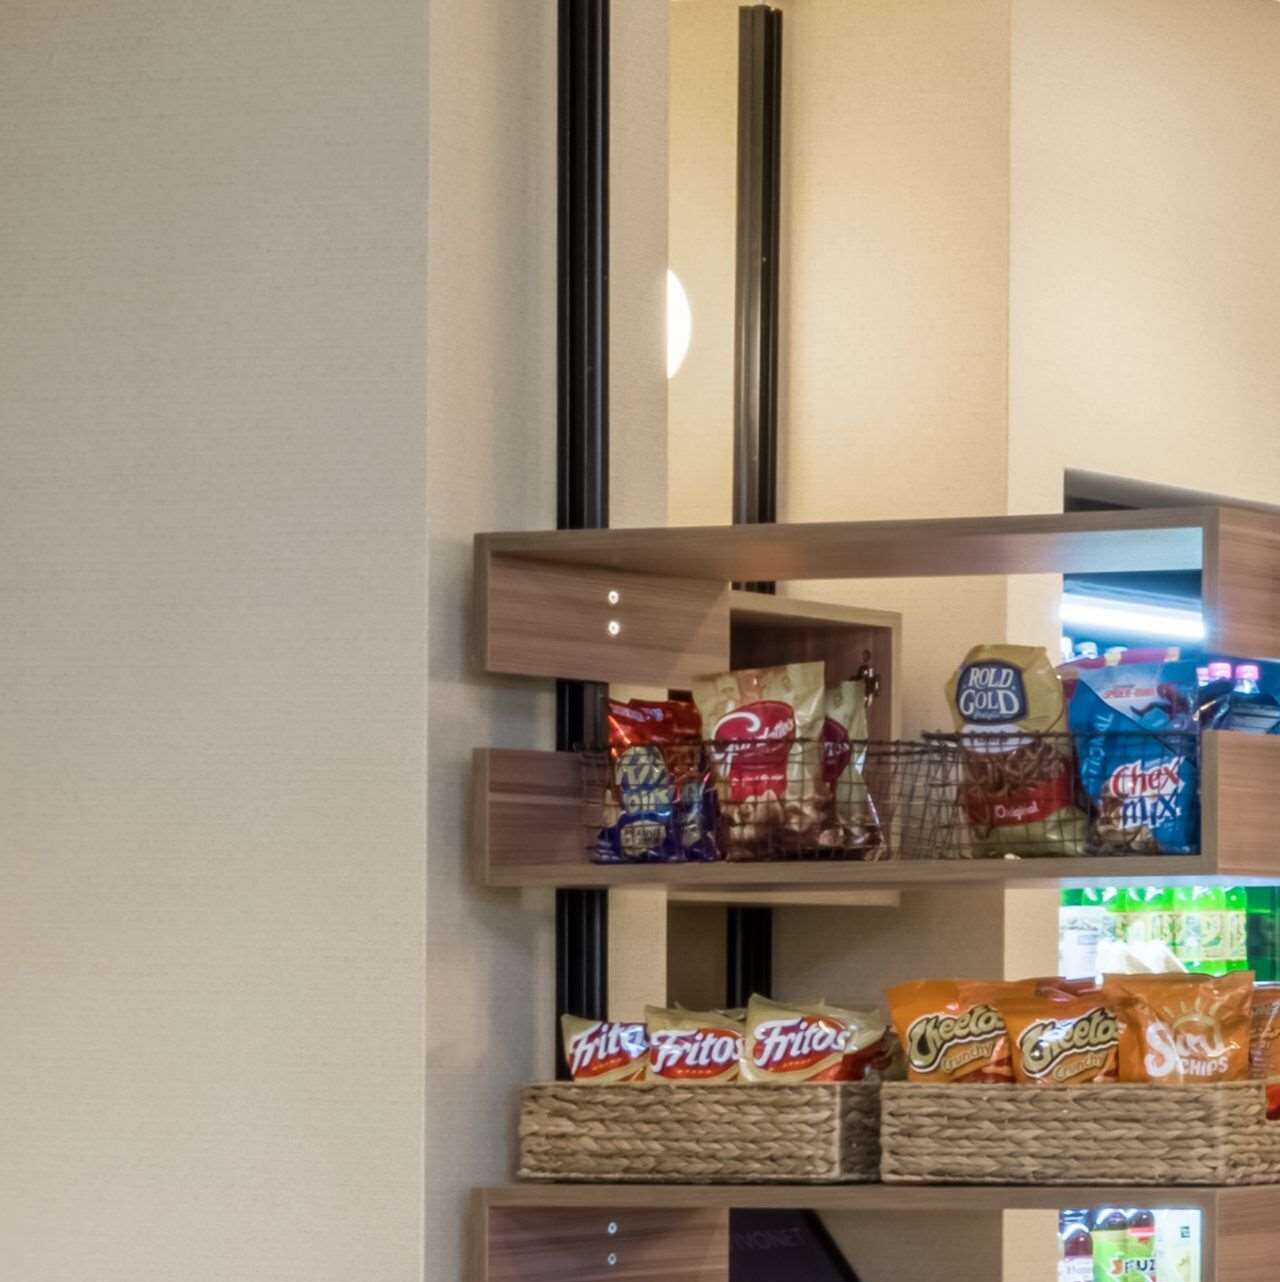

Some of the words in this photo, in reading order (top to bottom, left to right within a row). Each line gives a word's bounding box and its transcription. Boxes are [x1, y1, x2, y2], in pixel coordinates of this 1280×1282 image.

[968, 667, 1015, 689] ROLD
[960, 688, 1020, 716] GOLD
[1110, 758, 1185, 798] Chex
[752, 1018, 852, 1067] Fritos
[1181, 1056, 1229, 1077] CHIPS
